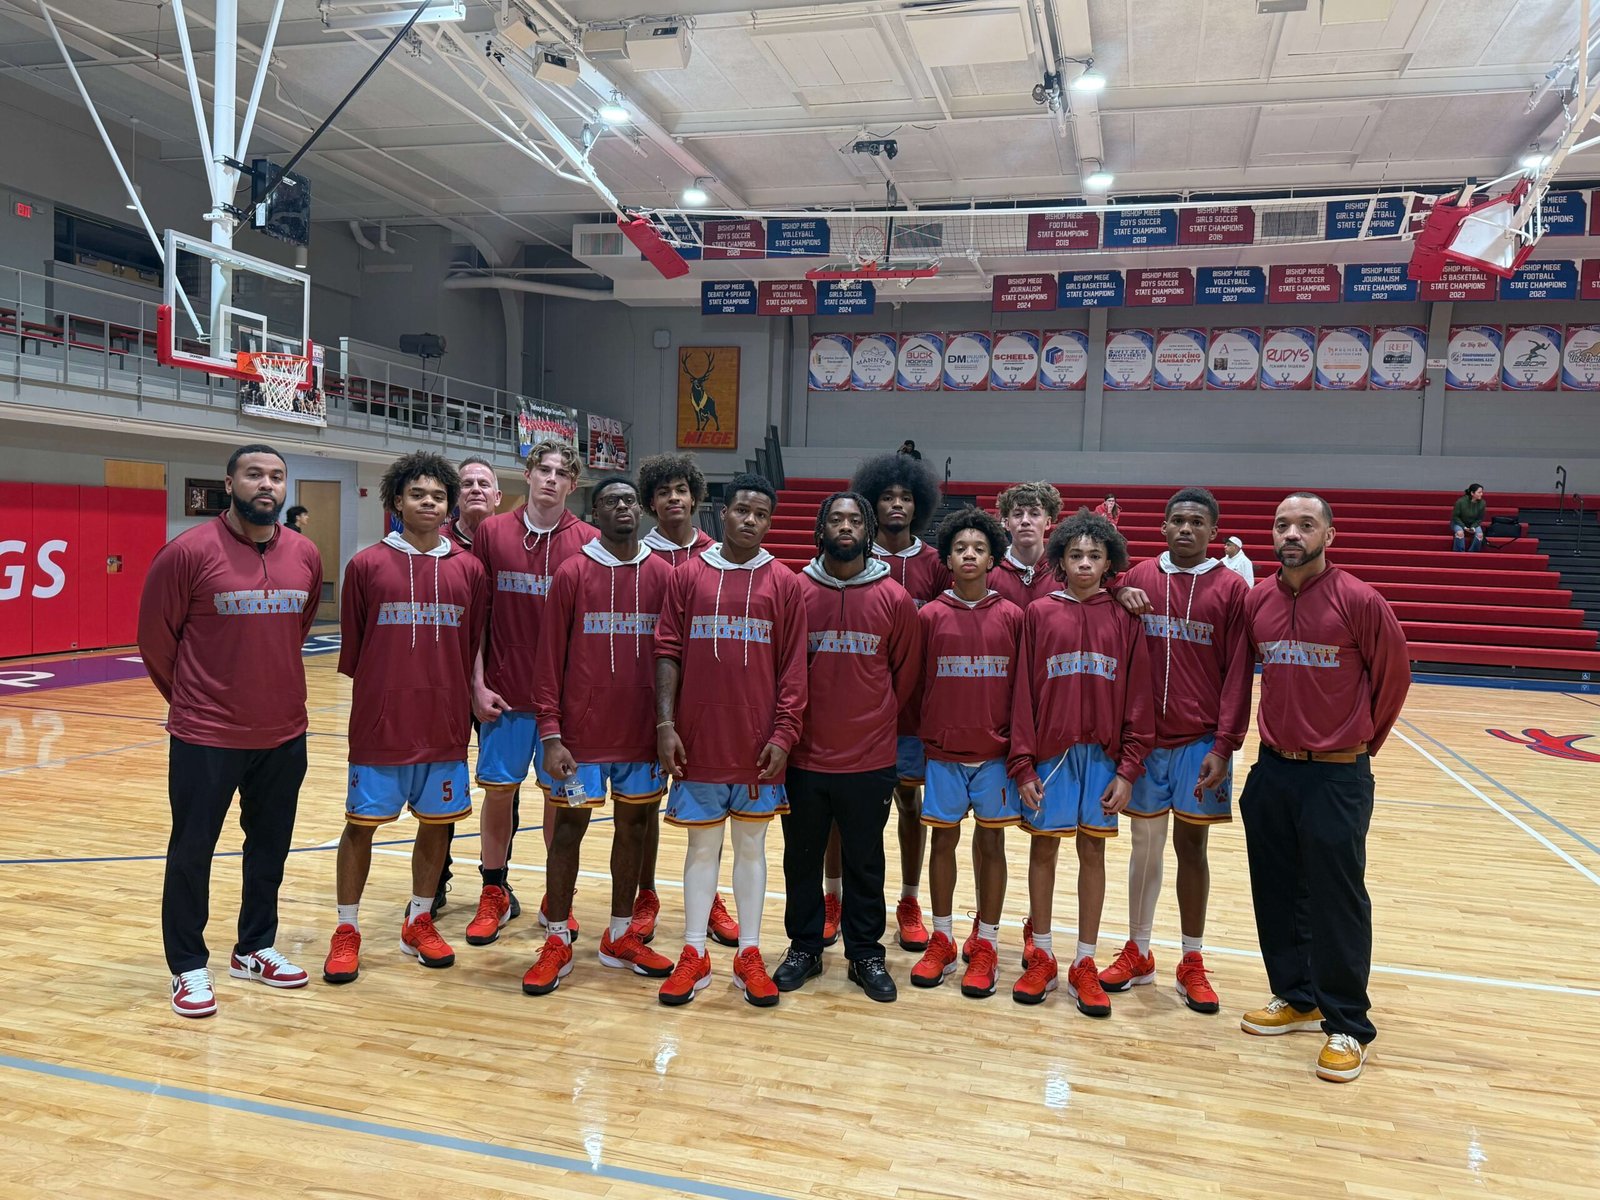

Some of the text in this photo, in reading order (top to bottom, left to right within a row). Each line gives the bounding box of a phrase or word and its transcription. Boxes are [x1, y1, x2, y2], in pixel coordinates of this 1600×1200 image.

[1547, 196, 1567, 204] MIEGE
[1121, 209, 1142, 217] BISHOP
[782, 222, 799, 230] BISHOP
[1120, 218, 1136, 226] BOYS
[1337, 221, 1356, 229] STATE
[718, 224, 736, 232] BISHOP
[1132, 227, 1167, 235] CHAMPIONS
[1209, 224, 1243, 232] CHAMPIONS
[783, 230, 814, 238] VOLLEYBALL
[948, 355, 966, 363] DM
[1266, 348, 1309, 362] RUDY'S
[684, 432, 733, 444] MIEGE
[442, 781, 452, 801] 5
